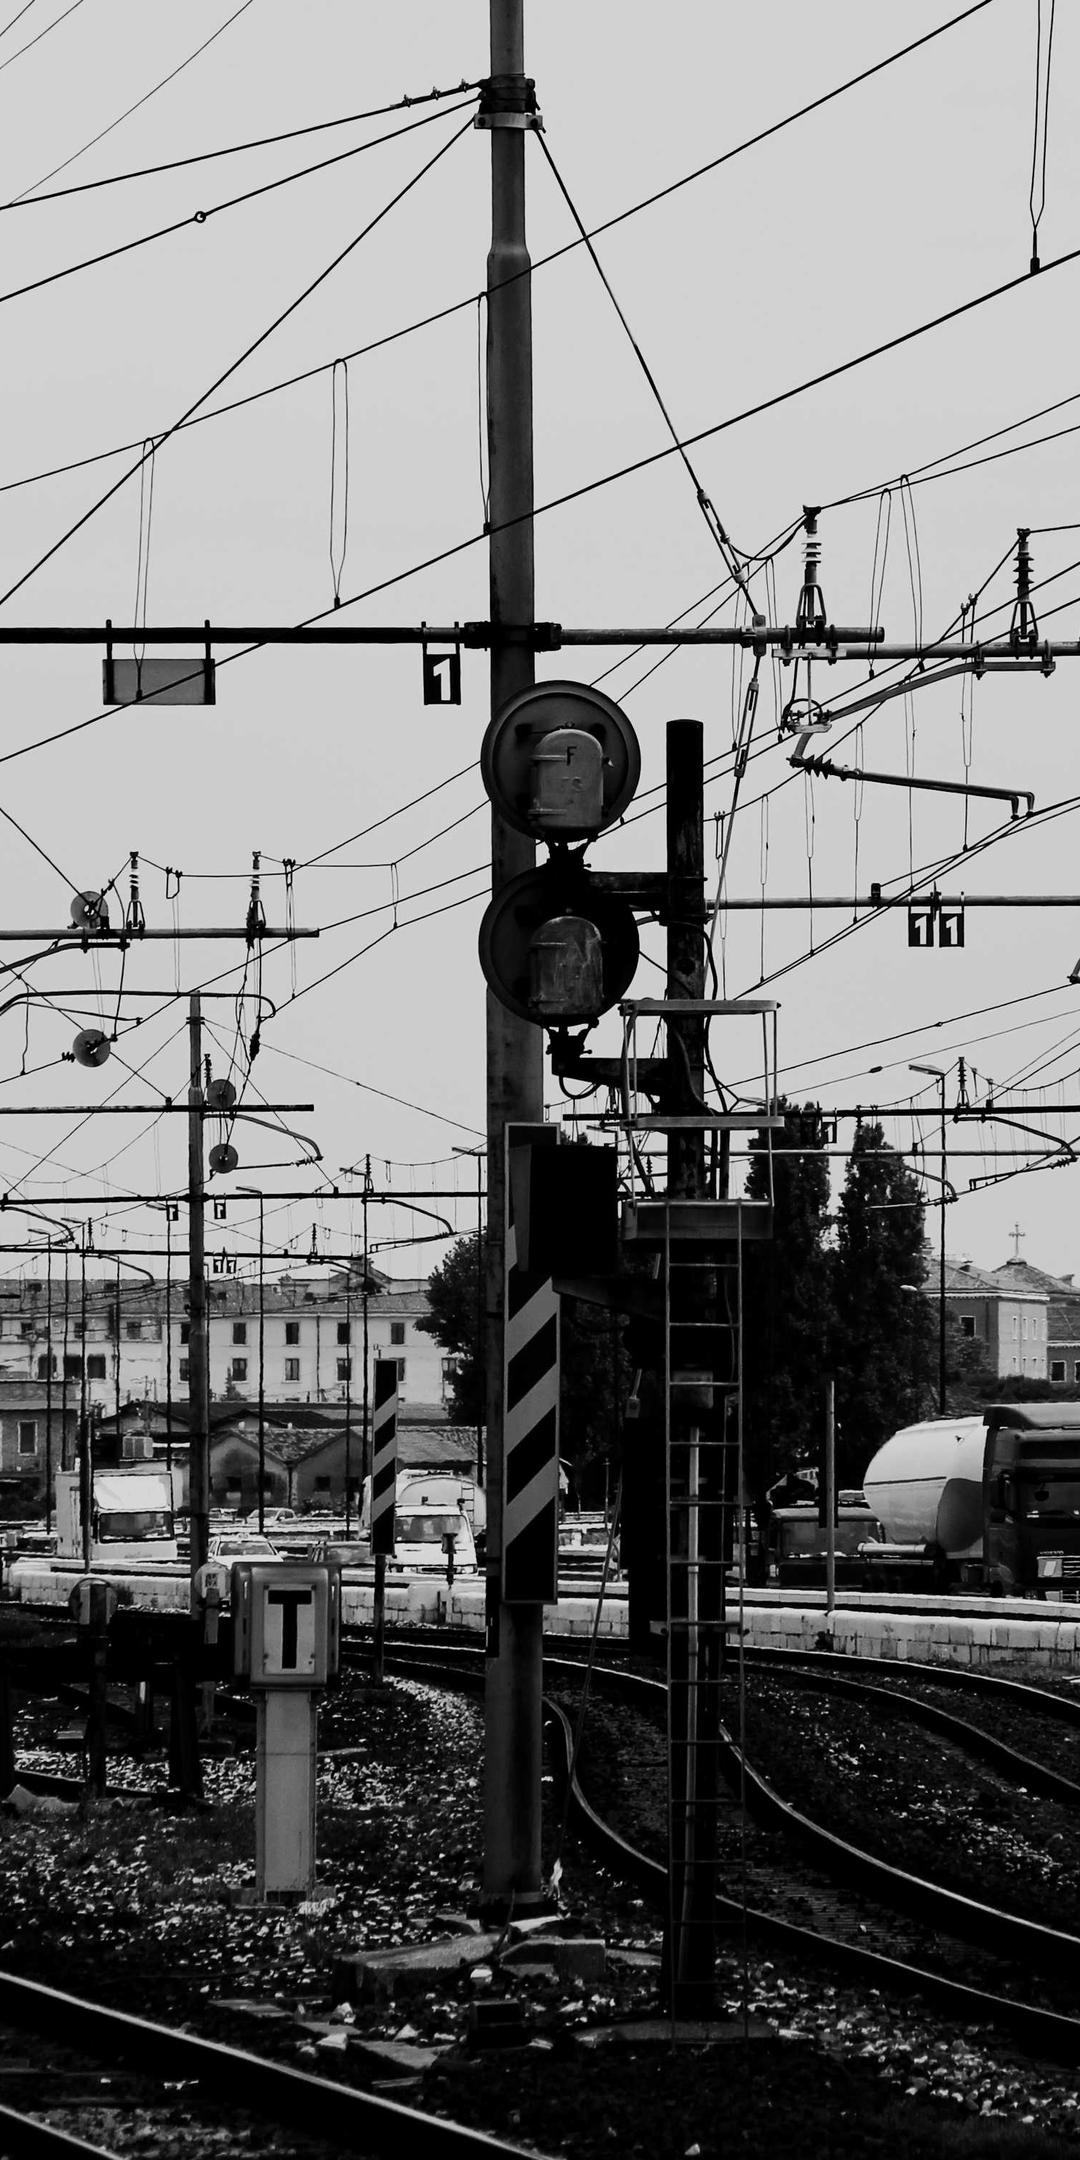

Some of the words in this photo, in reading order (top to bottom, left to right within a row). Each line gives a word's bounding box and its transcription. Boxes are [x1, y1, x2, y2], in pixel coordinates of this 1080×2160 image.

[432, 657, 452, 702] 1
[566, 745, 577, 767] F
[267, 1589, 312, 1669] T
